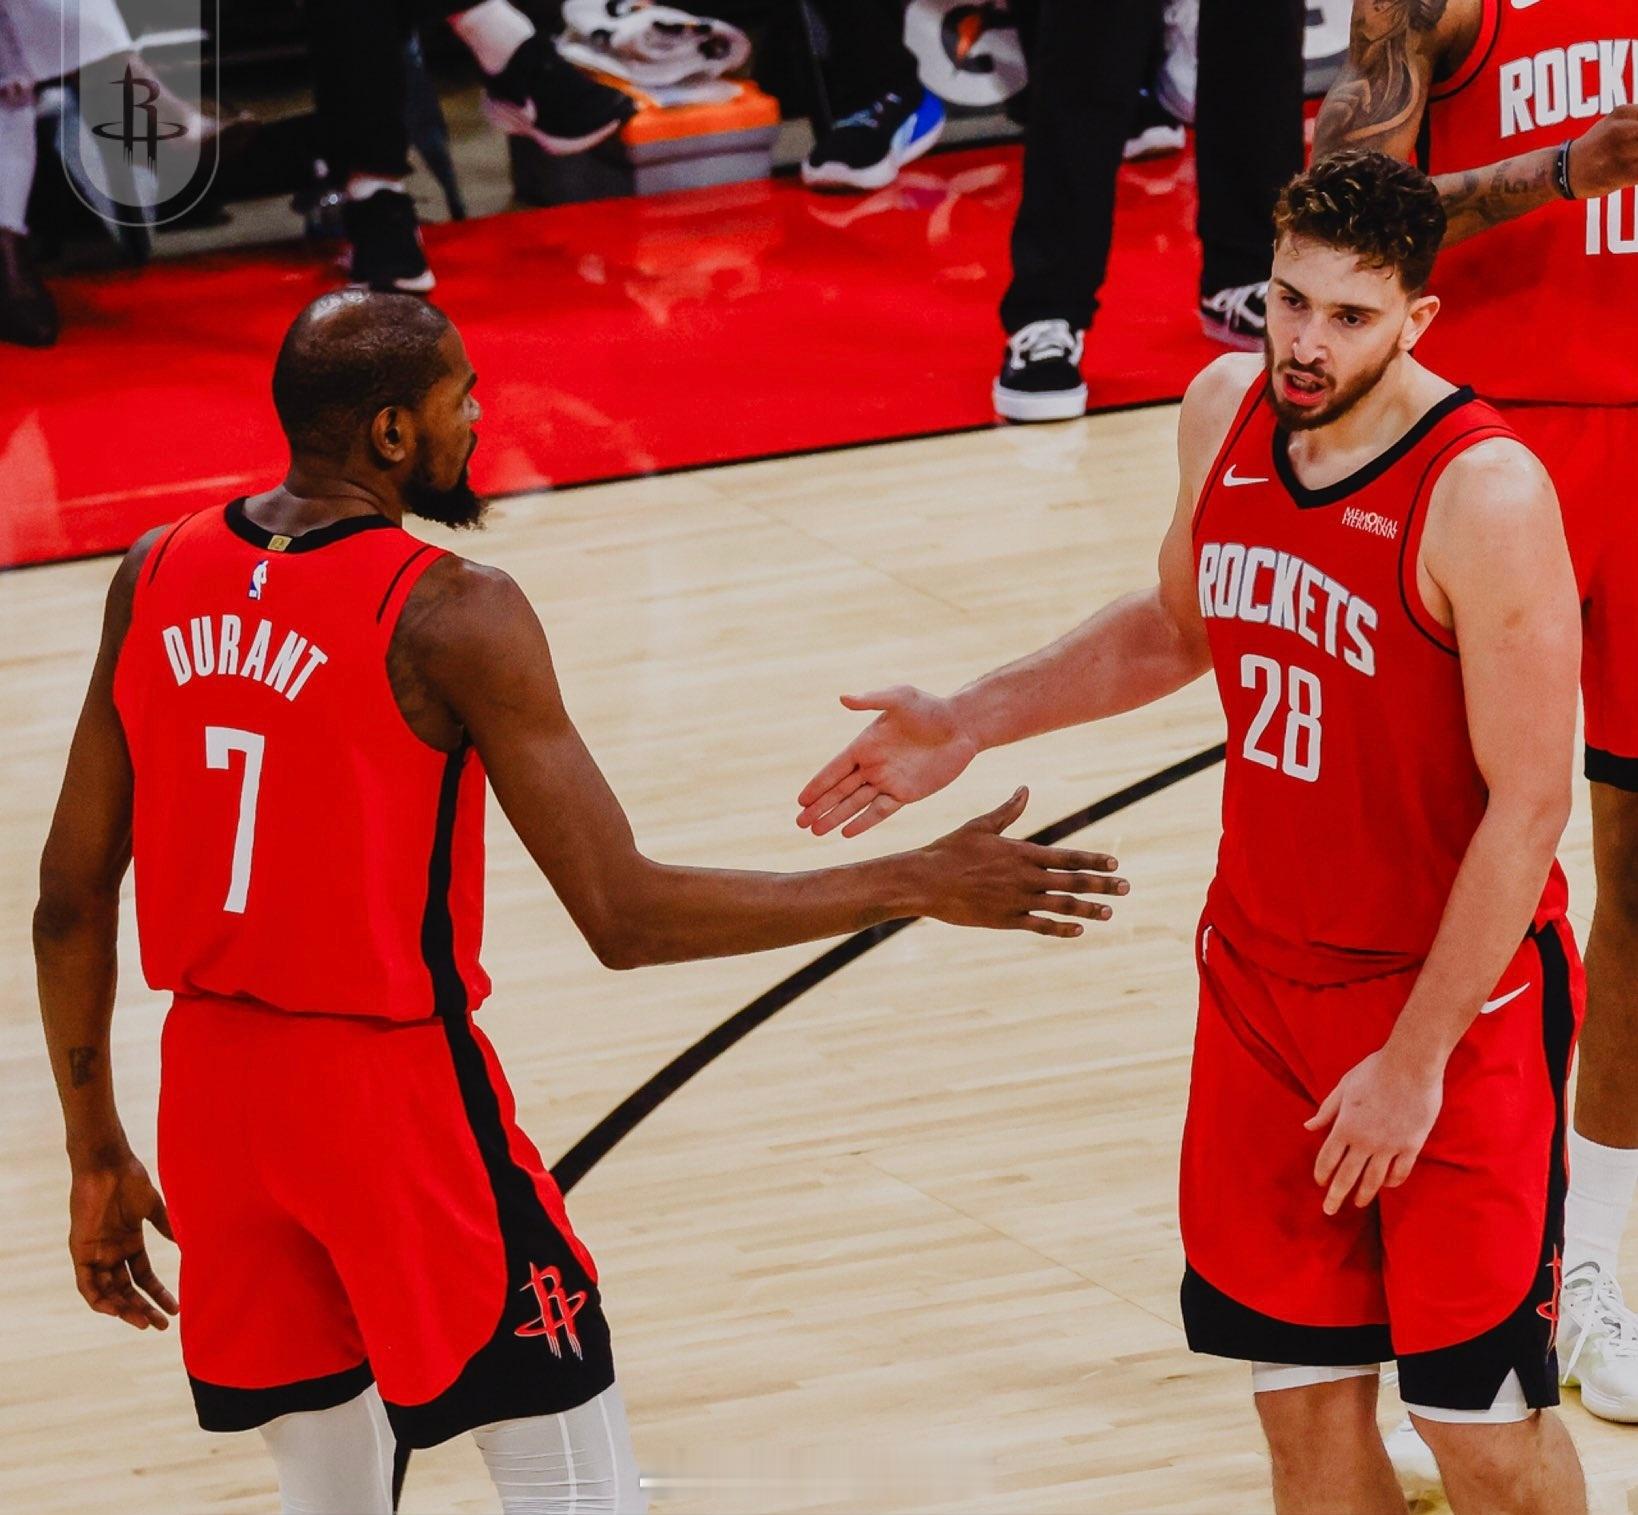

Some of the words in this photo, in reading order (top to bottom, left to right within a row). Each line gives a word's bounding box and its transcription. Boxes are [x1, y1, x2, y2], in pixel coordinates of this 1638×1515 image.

[1499, 38, 1638, 139] ROCK
[1341, 513, 1396, 540] HERMANN
[1344, 506, 1398, 532] MEMORIAL
[162, 614, 329, 702] DURANT
[1198, 542, 1378, 677] ROCKETS
[1240, 653, 1322, 782] 28
[205, 725, 265, 914] 7
